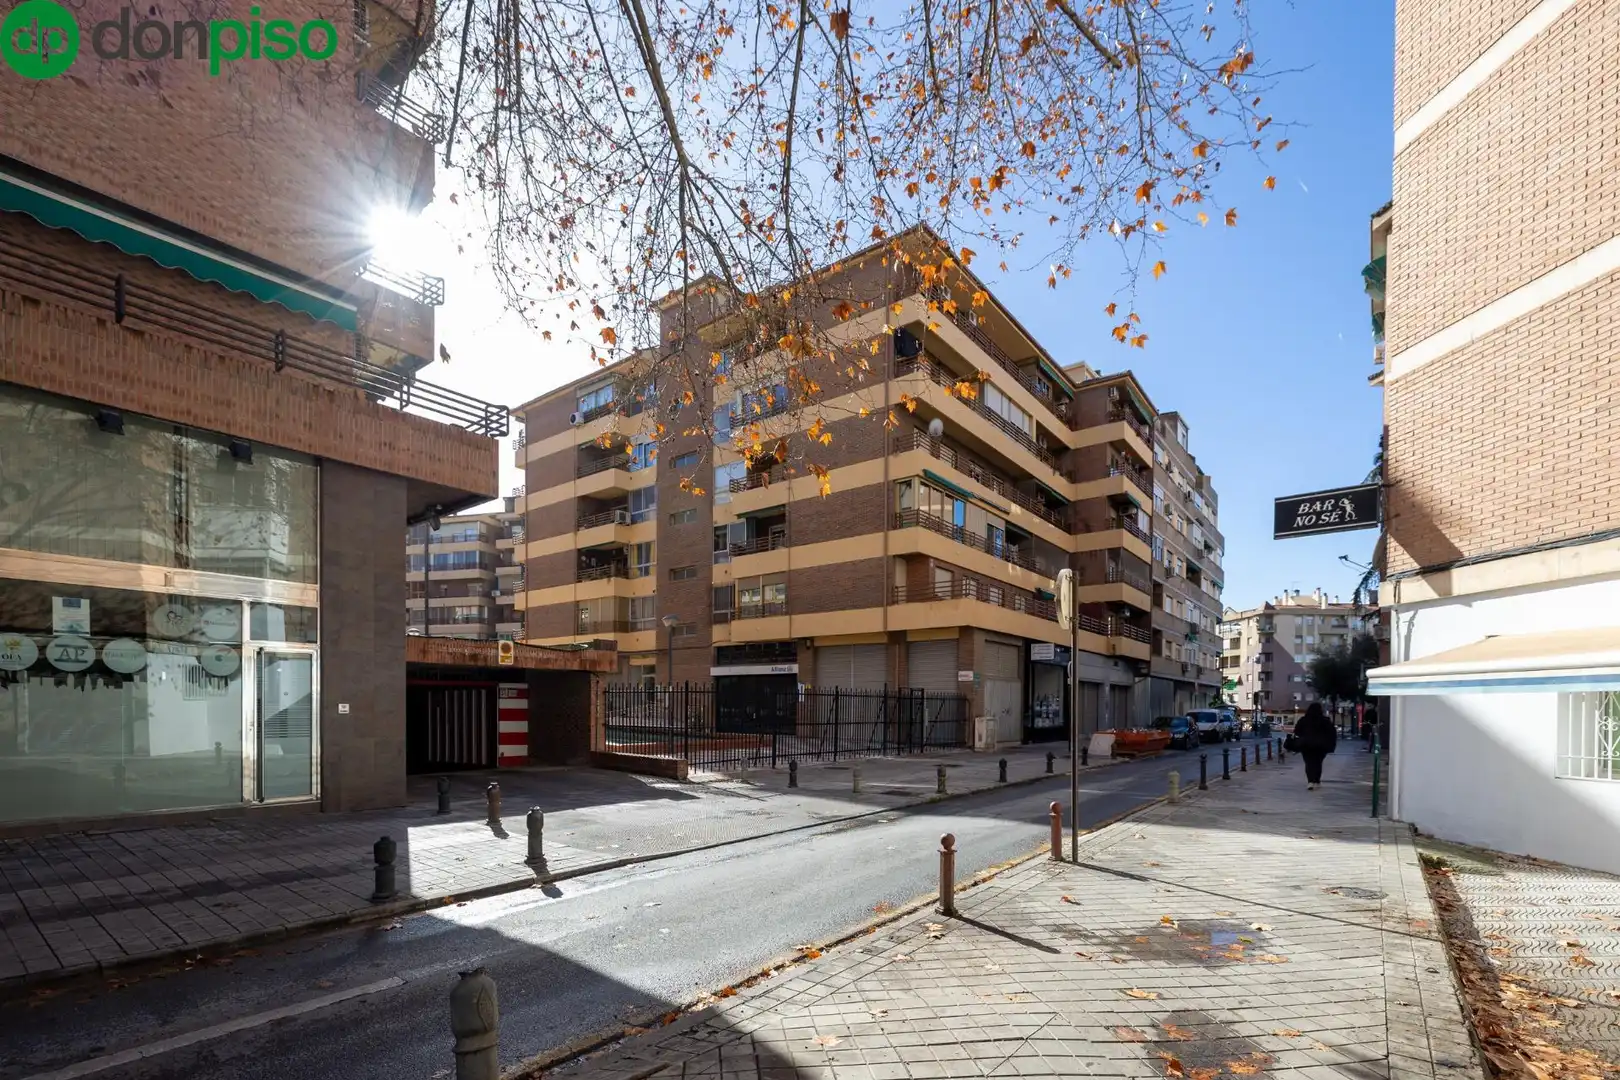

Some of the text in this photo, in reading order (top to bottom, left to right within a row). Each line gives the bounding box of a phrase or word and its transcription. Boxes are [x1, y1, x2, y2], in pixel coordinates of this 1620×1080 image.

[1298, 498, 1335, 514] BAR
[1293, 508, 1342, 528] NO SÉ
